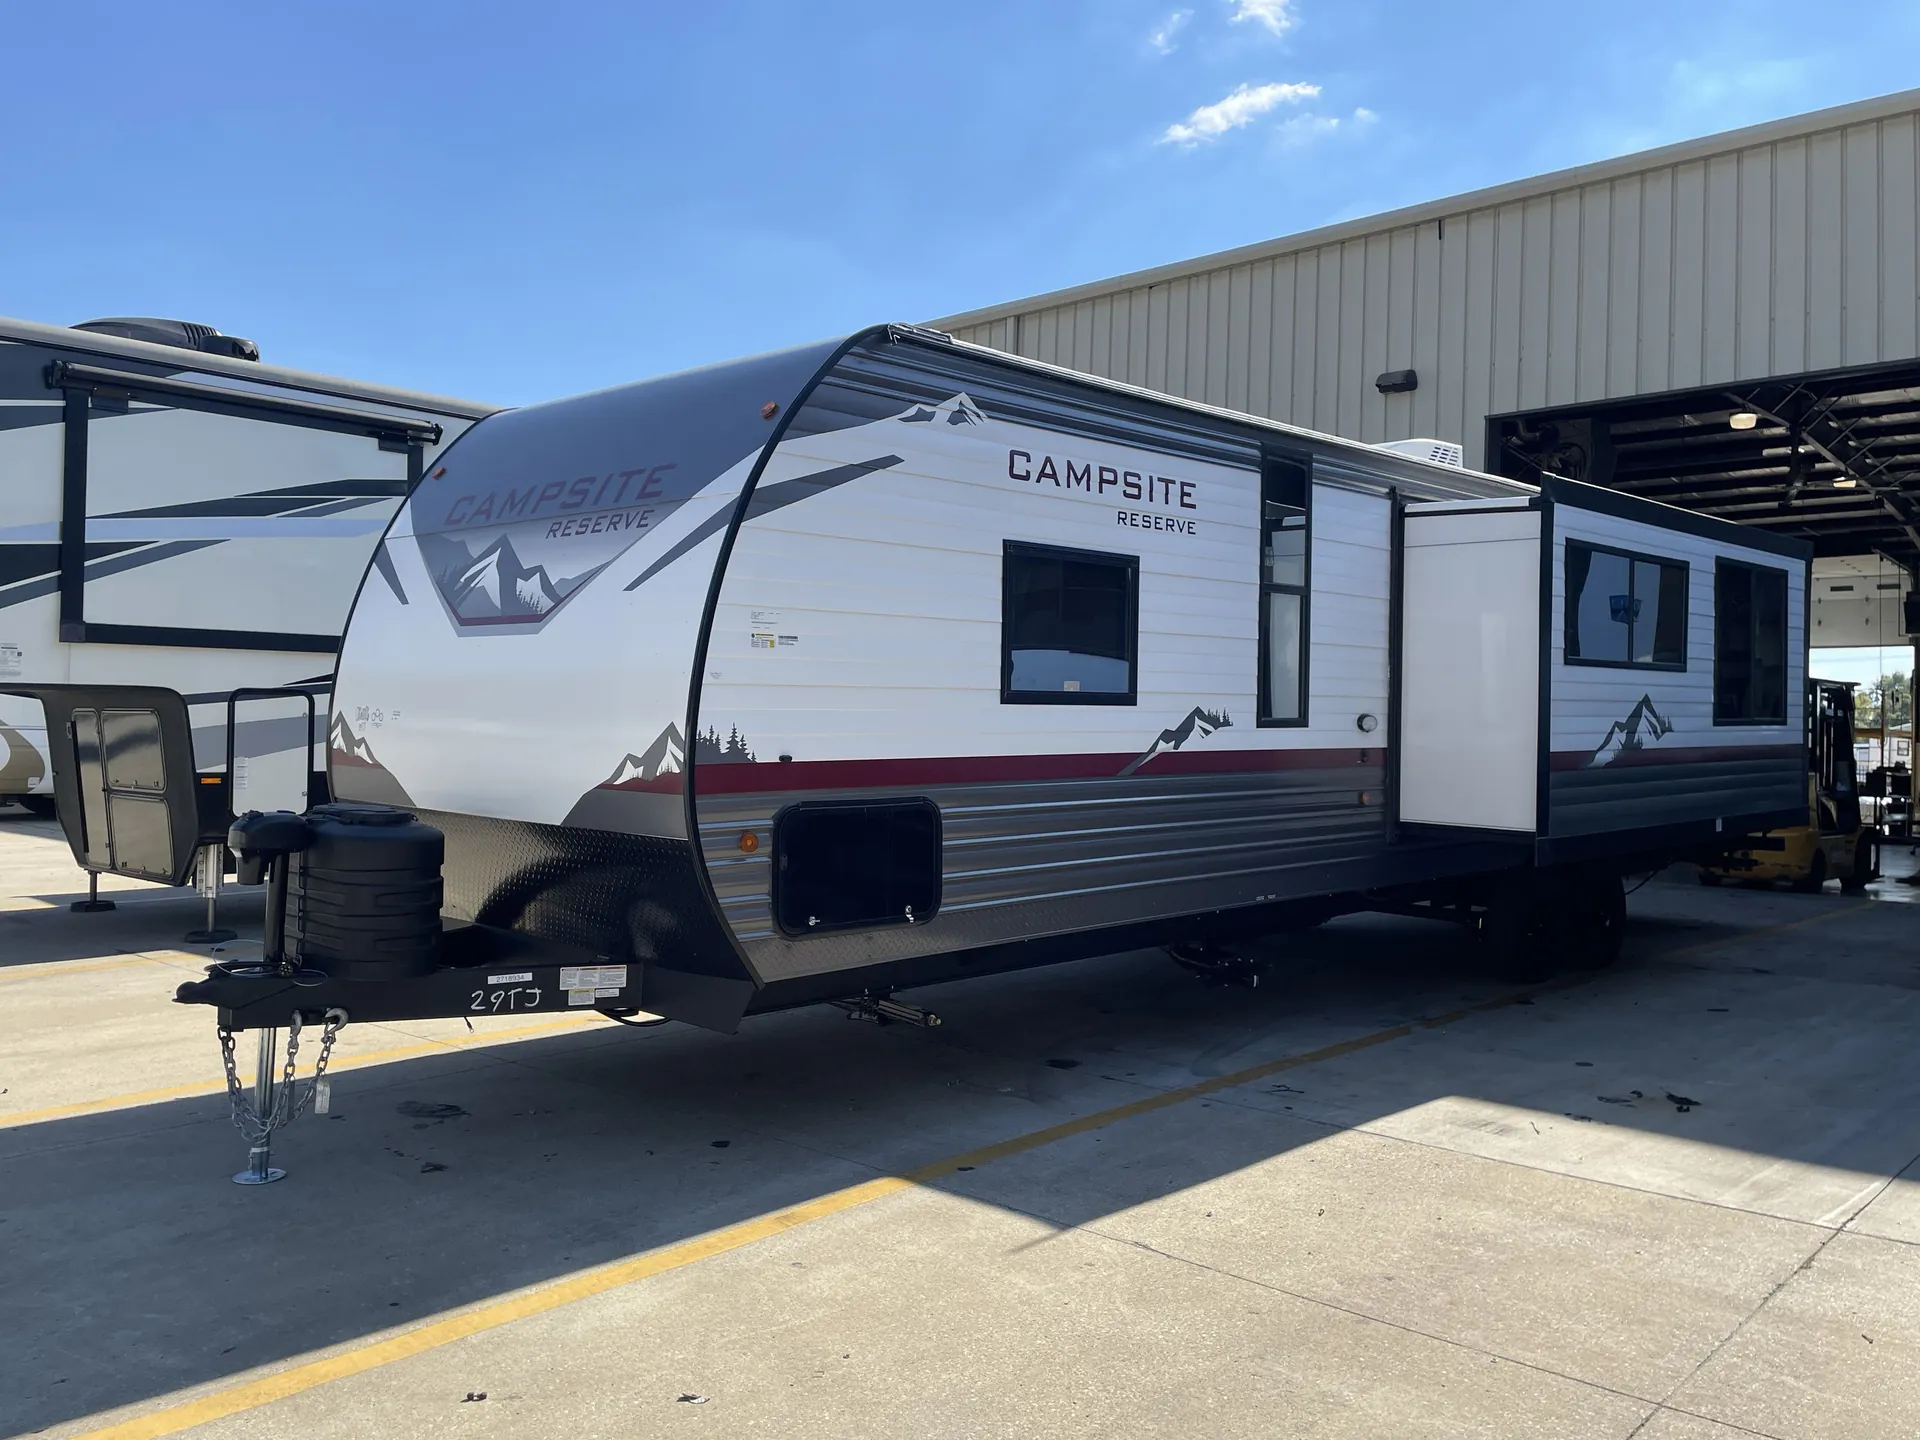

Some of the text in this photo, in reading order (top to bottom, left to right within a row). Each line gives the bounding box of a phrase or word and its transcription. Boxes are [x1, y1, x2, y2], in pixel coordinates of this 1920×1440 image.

[1008, 449, 1197, 510] CAMPSITE
[444, 462, 678, 526] CAMPSITE
[545, 508, 655, 540] RESERVE
[1117, 510, 1196, 535] RESERVE
[495, 974, 525, 983] 2718934
[470, 987, 542, 1012] 29TJ
